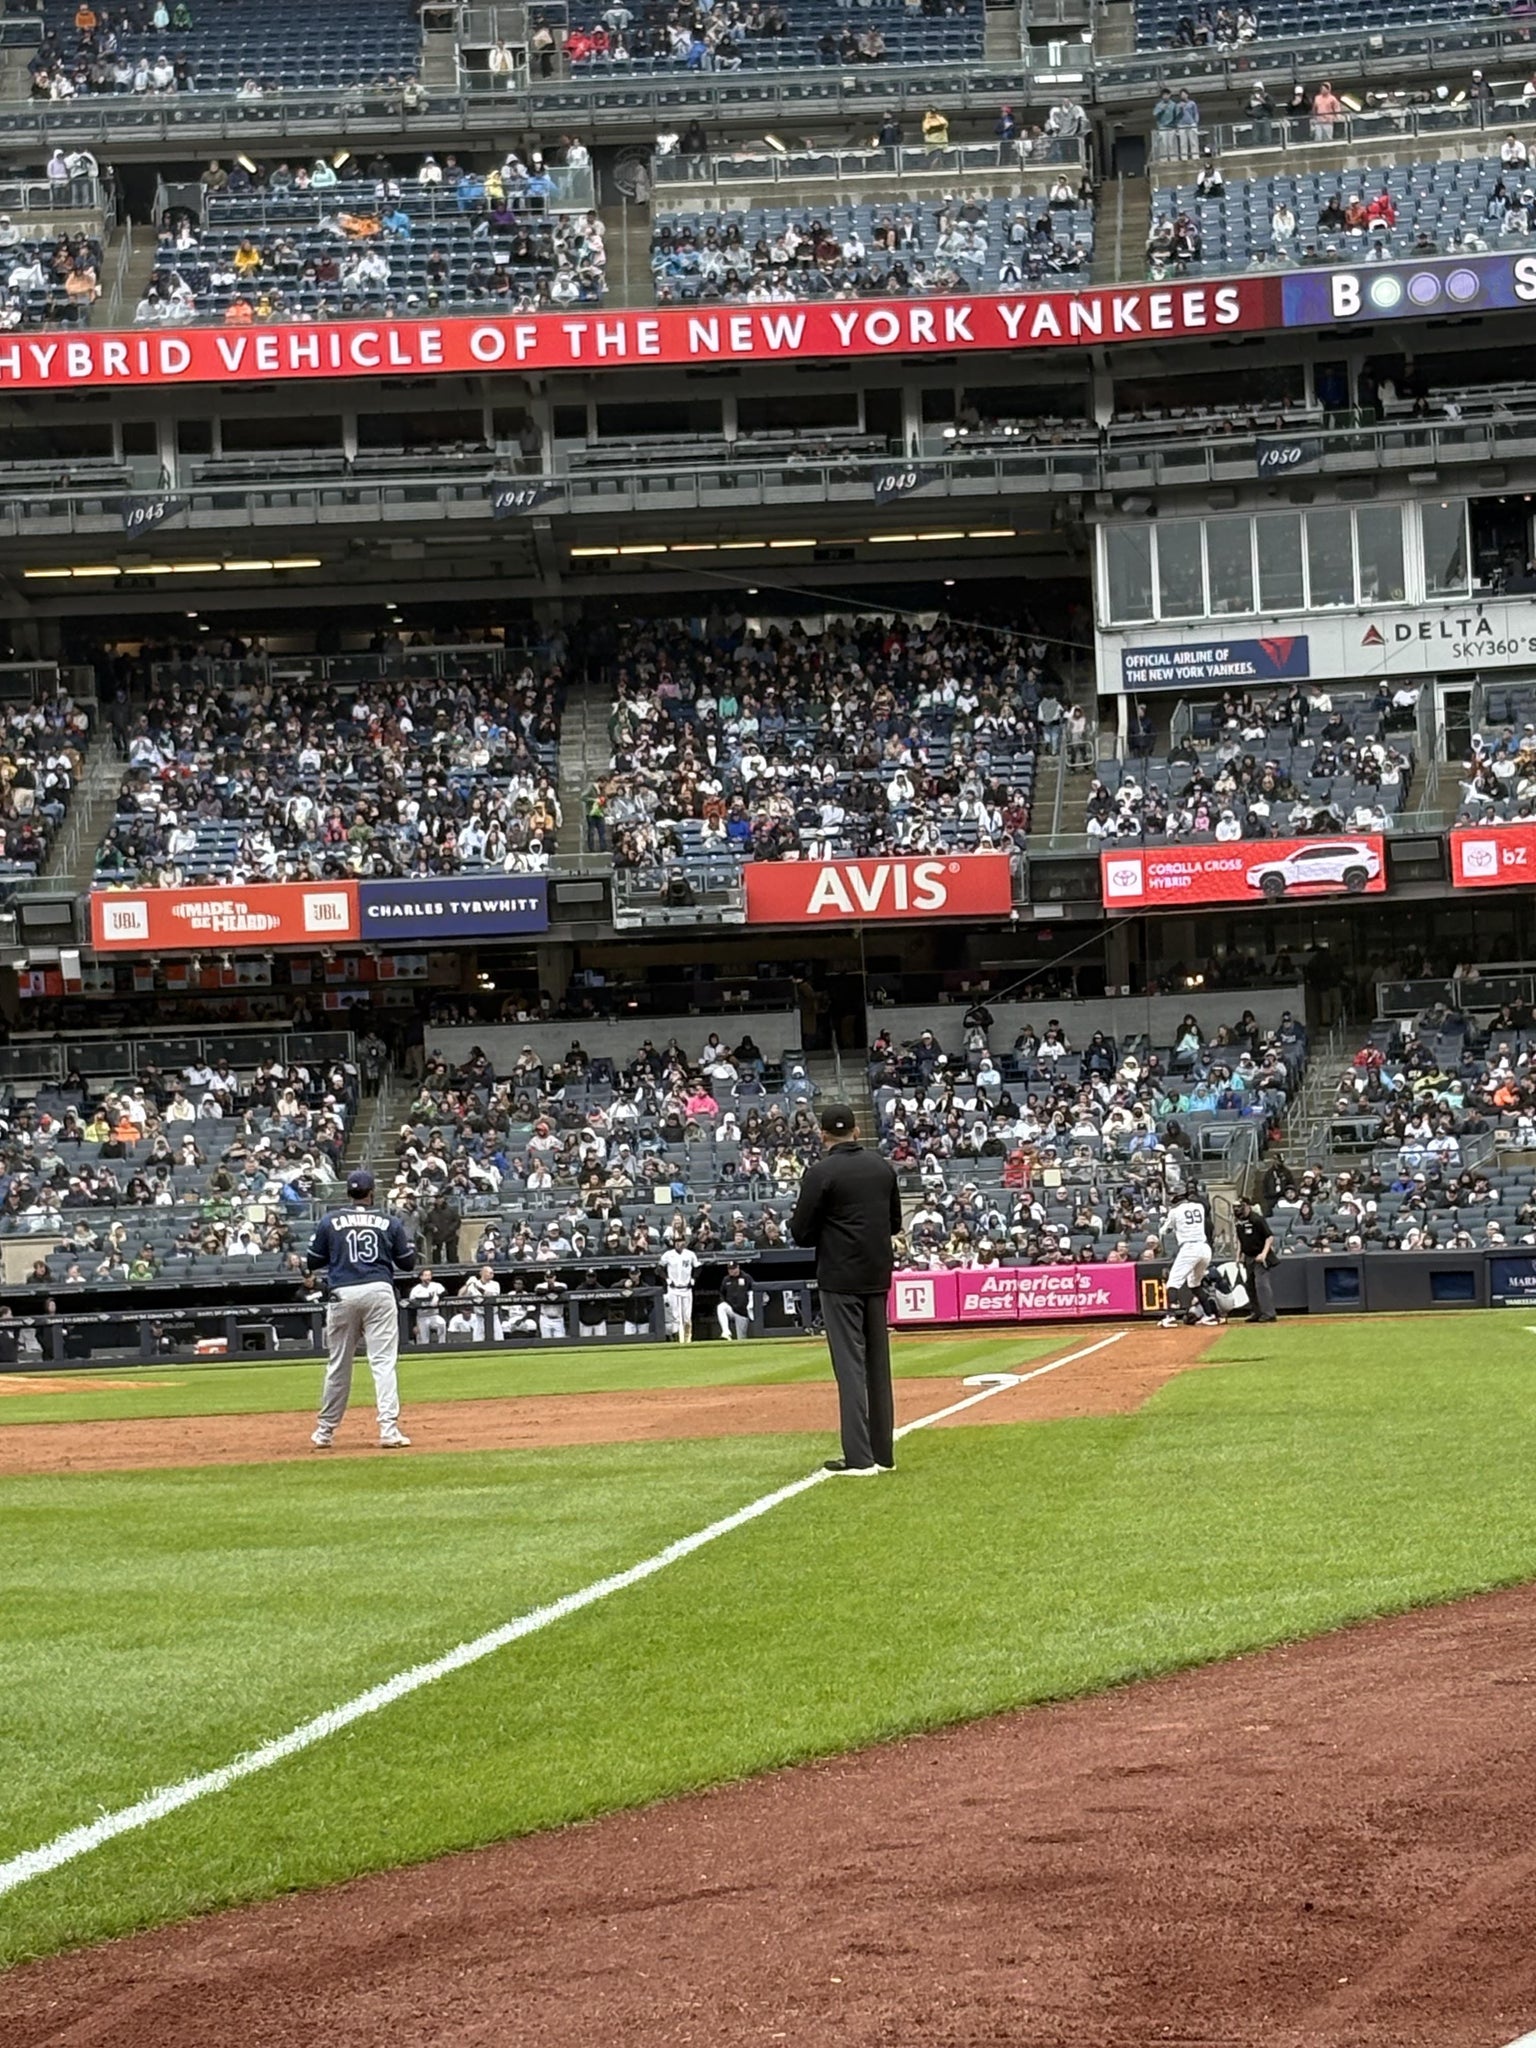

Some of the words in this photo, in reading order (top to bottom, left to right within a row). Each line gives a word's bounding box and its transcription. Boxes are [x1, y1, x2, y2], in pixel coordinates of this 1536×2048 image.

[1330, 274, 1362, 317] B
[0, 338, 191, 379] HYBRID
[216, 328, 443, 371] VEHICLE
[470, 325, 538, 362] OF
[562, 319, 661, 358] THE
[688, 312, 806, 353] NEW
[830, 306, 975, 347] YORK
[997, 288, 1241, 340] YANKEES
[1260, 447, 1301, 466] 1950
[876, 472, 917, 492] 1949
[495, 490, 537, 508] 1947
[1394, 618, 1493, 642] DELTA
[1125, 653, 1171, 668] OFFICIAL
[1173, 650, 1214, 665] AIRLINE
[1215, 648, 1229, 662] OF
[1126, 669, 1147, 682] THE
[1148, 667, 1174, 681] NEW
[1175, 665, 1205, 680] YORK
[1147, 861, 1203, 876] COROLLA
[1204, 858, 1243, 873] CROSS
[1149, 876, 1192, 889] HYBRID
[186, 901, 234, 916] MADE
[313, 903, 342, 921] JBL
[367, 903, 444, 917] CHARLES
[450, 899, 539, 914] TYRWHITT
[112, 912, 141, 930] JBL
[212, 914, 267, 932] HEARD
[331, 1214, 390, 1231] CAMINERO
[1184, 1209, 1203, 1225] 99
[346, 1229, 378, 1263] 13
[981, 1272, 1092, 1293] America's
[905, 1287, 926, 1312] T
[964, 1293, 1014, 1311] Best
[1018, 1289, 1111, 1309] Network
